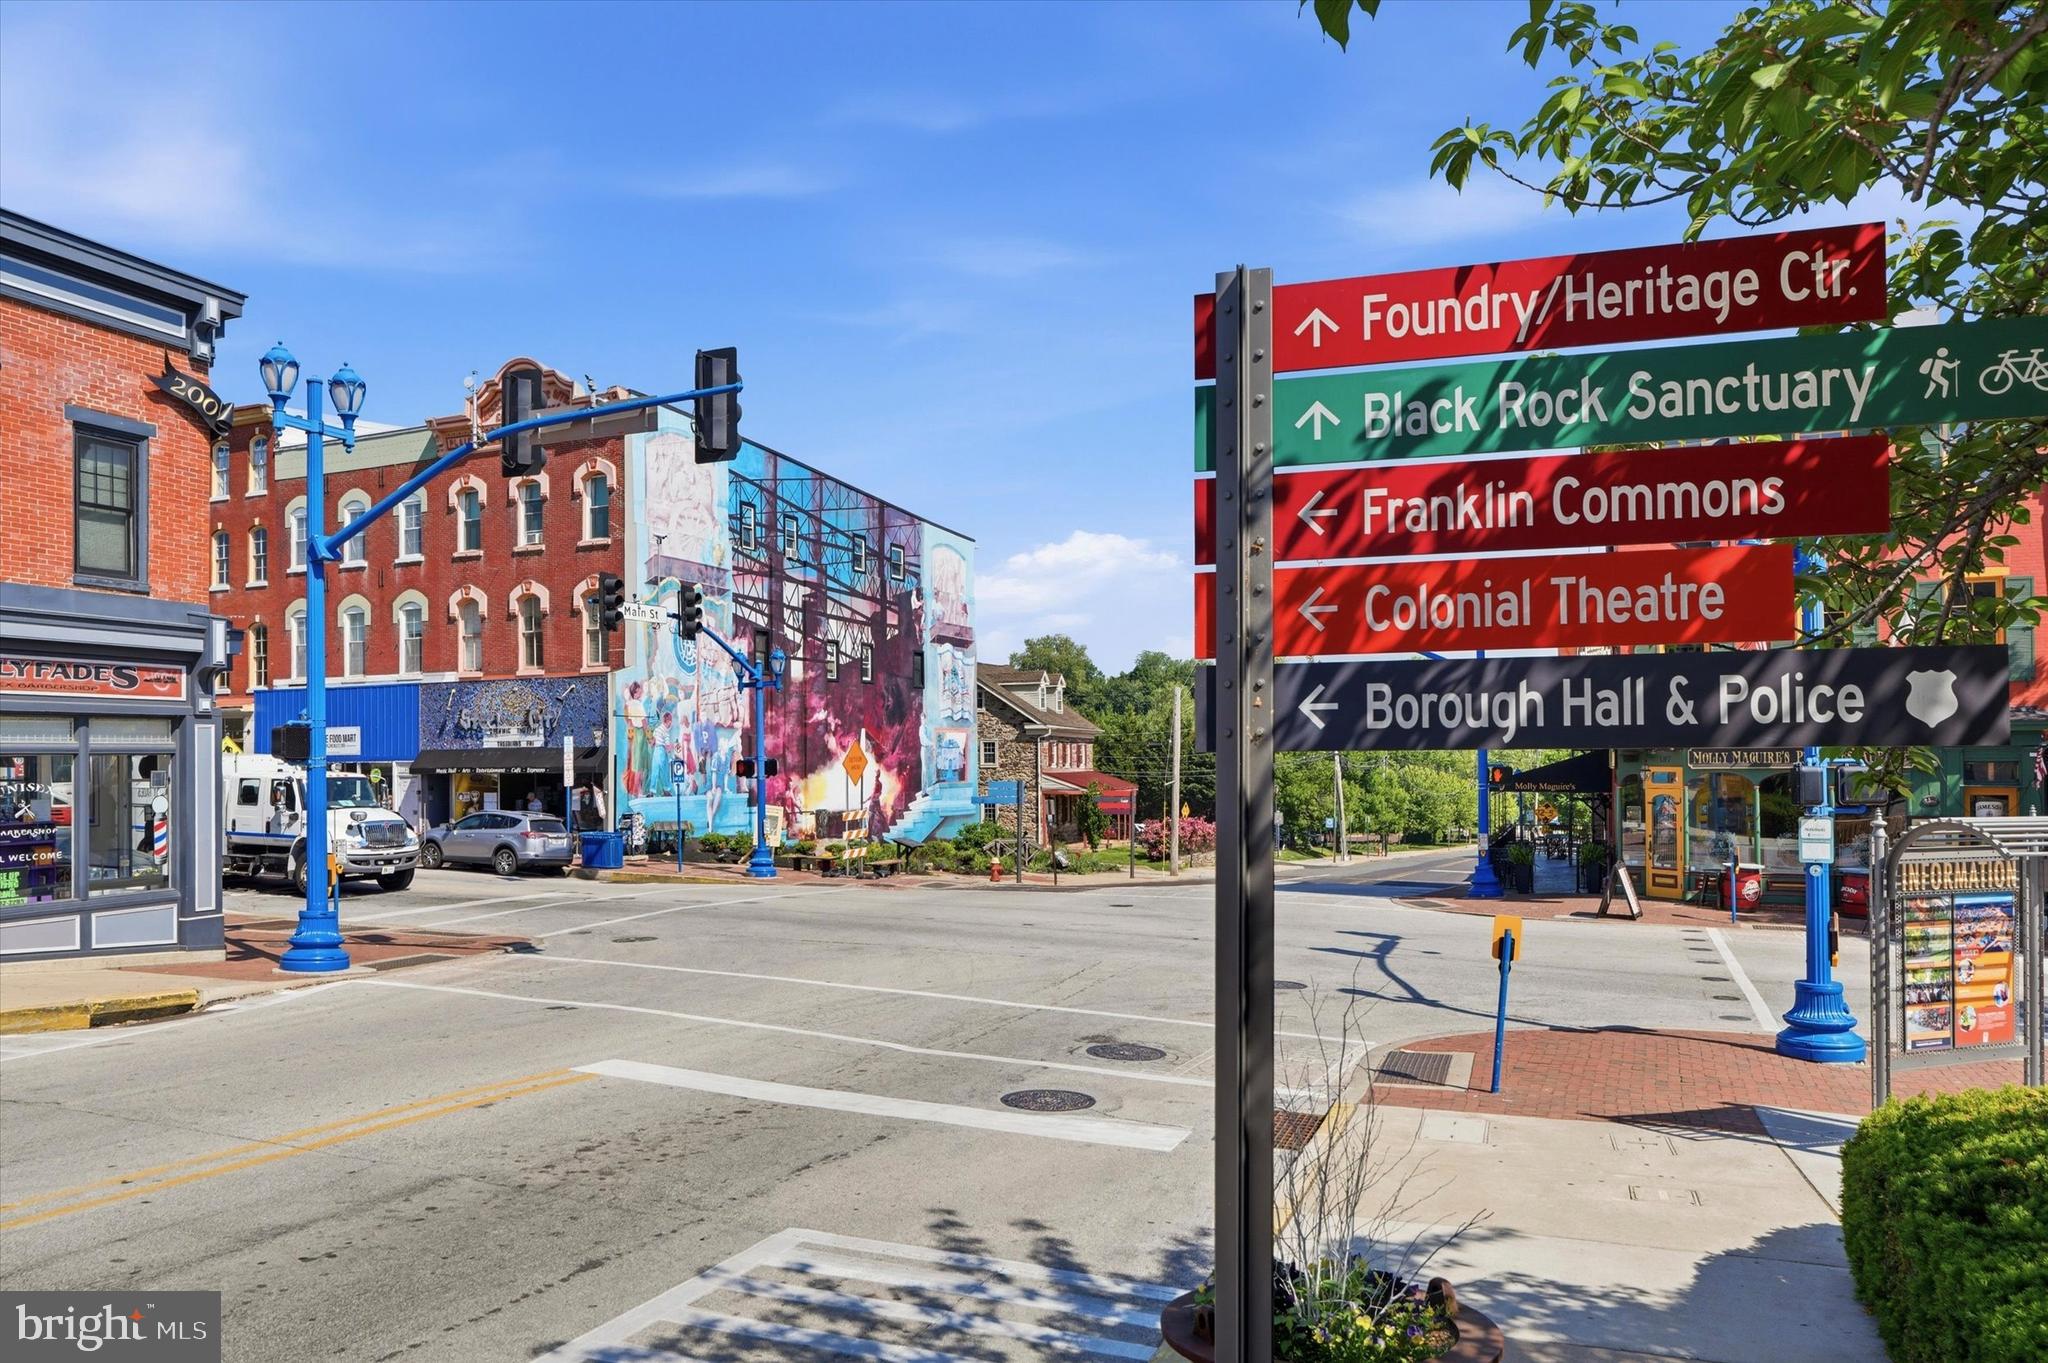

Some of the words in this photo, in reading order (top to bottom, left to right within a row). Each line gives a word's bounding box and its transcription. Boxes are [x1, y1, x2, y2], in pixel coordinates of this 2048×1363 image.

[1363, 265, 1759, 343] Foundry/Heritage
[1780, 249, 1857, 302] Ctr.
[1364, 384, 1481, 439] Black
[1498, 377, 1607, 430] Rock
[1627, 362, 1876, 422] Sanctuary
[1363, 480, 1534, 535] Franklin
[1552, 473, 1785, 525] Commons
[624, 606, 646, 617] Main
[649, 609, 659, 619] St
[1365, 578, 1531, 632] Colonial
[1550, 573, 1725, 625] Theatre
[1366, 681, 1545, 744] Borough
[1562, 676, 1645, 727] Hall
[1665, 675, 1699, 726] &
[1719, 671, 1865, 725] Police
[329, 734, 342, 743] FOOD
[343, 734, 357, 743] MART
[1693, 751, 1728, 763] MOLLY
[1732, 751, 1790, 763] MAGUIRE'S
[1515, 783, 1537, 791] Molly
[1540, 783, 1576, 791] Maguire's
[8, 851, 62, 862] WELCOME
[1902, 860, 2017, 891] INFORMATION
